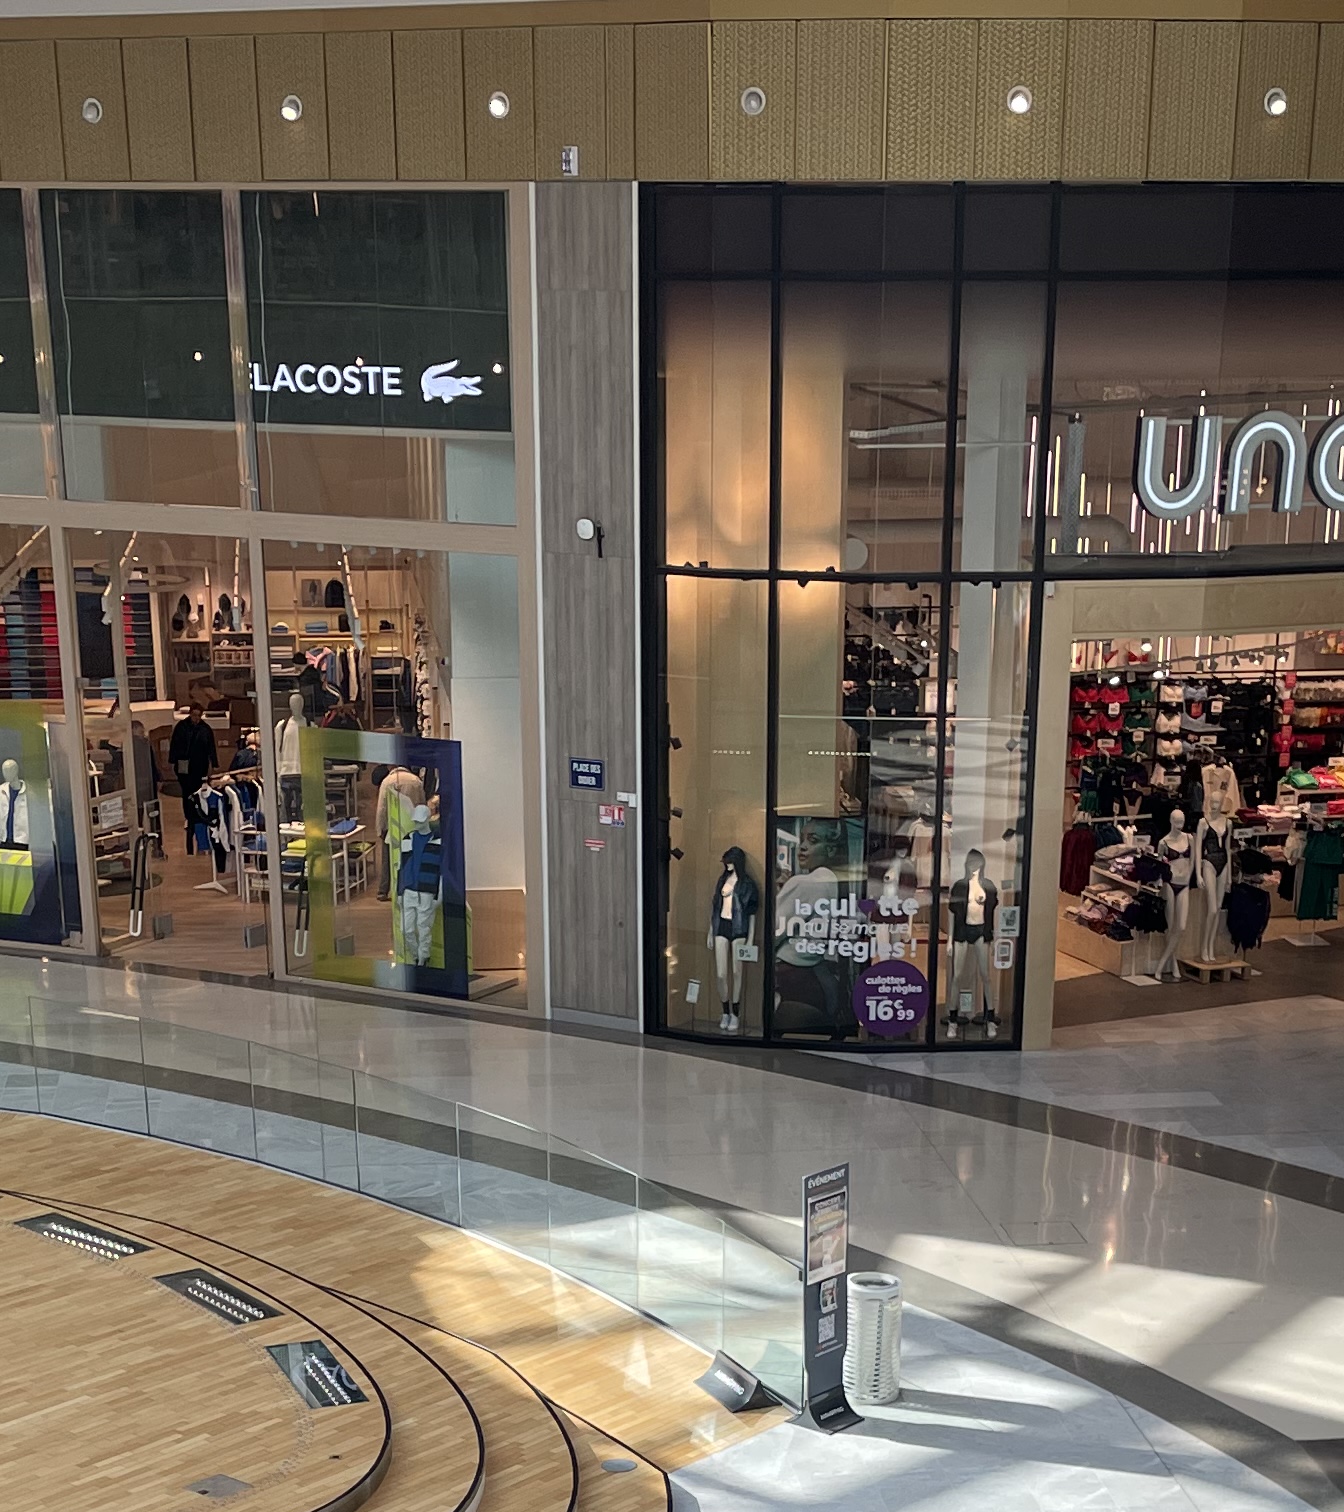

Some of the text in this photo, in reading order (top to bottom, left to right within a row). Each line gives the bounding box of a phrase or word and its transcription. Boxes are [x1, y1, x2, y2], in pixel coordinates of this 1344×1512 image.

[252, 362, 403, 396] LACOSTE
[795, 899, 812, 915] la
[795, 938, 826, 956] des
[828, 935, 905, 963] règles
[865, 976, 906, 985] culottes
[878, 984, 922, 995] de règles
